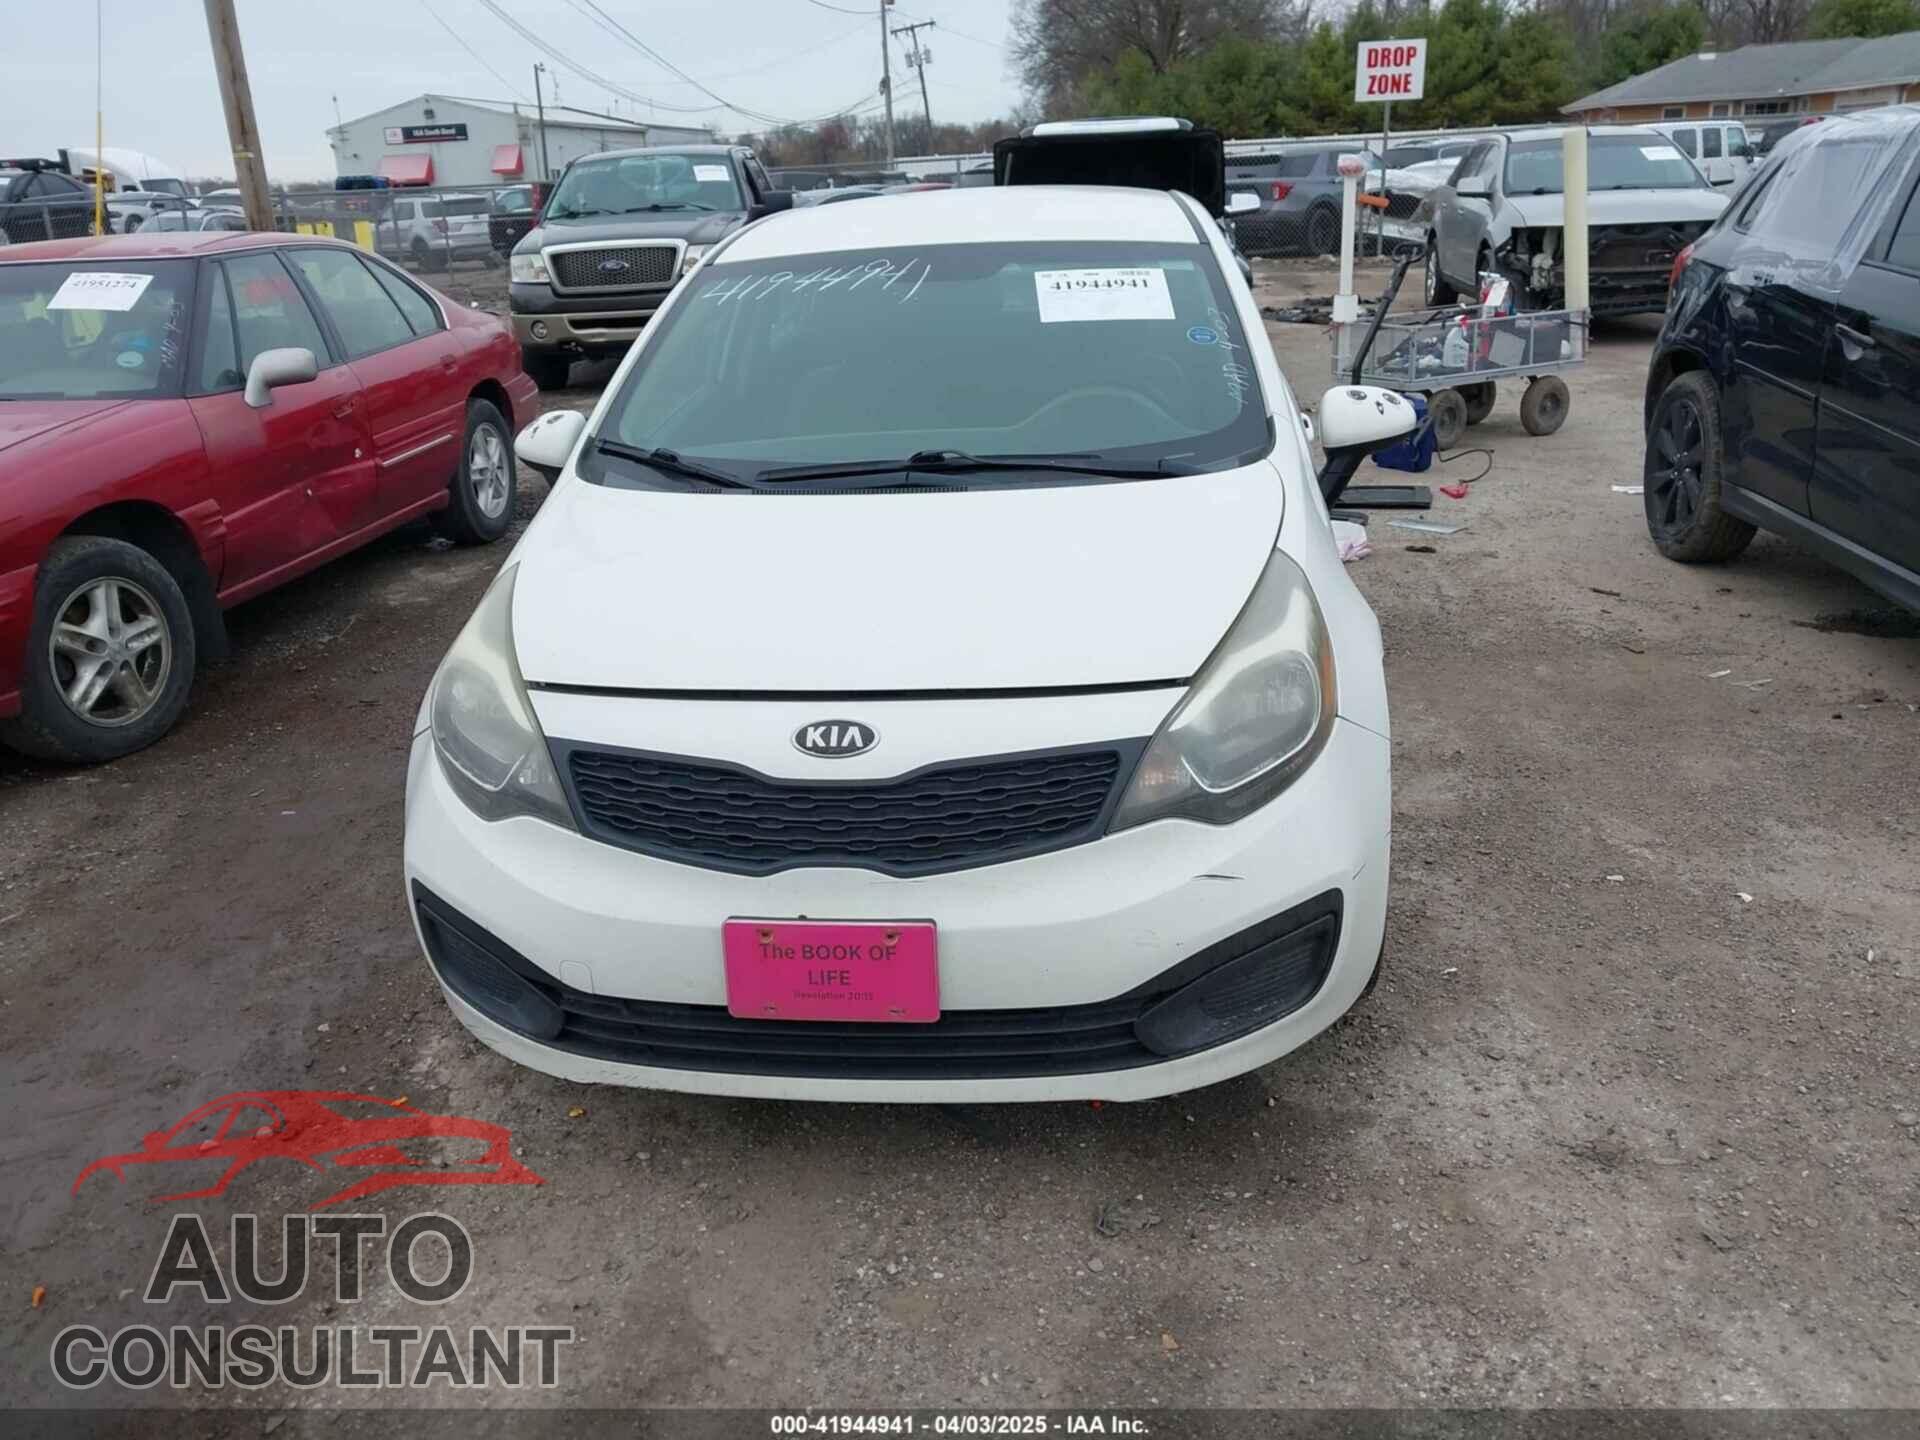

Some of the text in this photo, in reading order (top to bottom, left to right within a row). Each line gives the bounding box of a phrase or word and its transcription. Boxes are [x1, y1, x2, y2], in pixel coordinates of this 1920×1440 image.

[1367, 46, 1417, 68] DROP
[1367, 73, 1412, 95] ZONE
[1050, 279, 1149, 290] 41944941
[806, 725, 864, 747] KIA
[759, 944, 897, 961] The BOOK OF
[807, 969, 851, 986] LIFE
